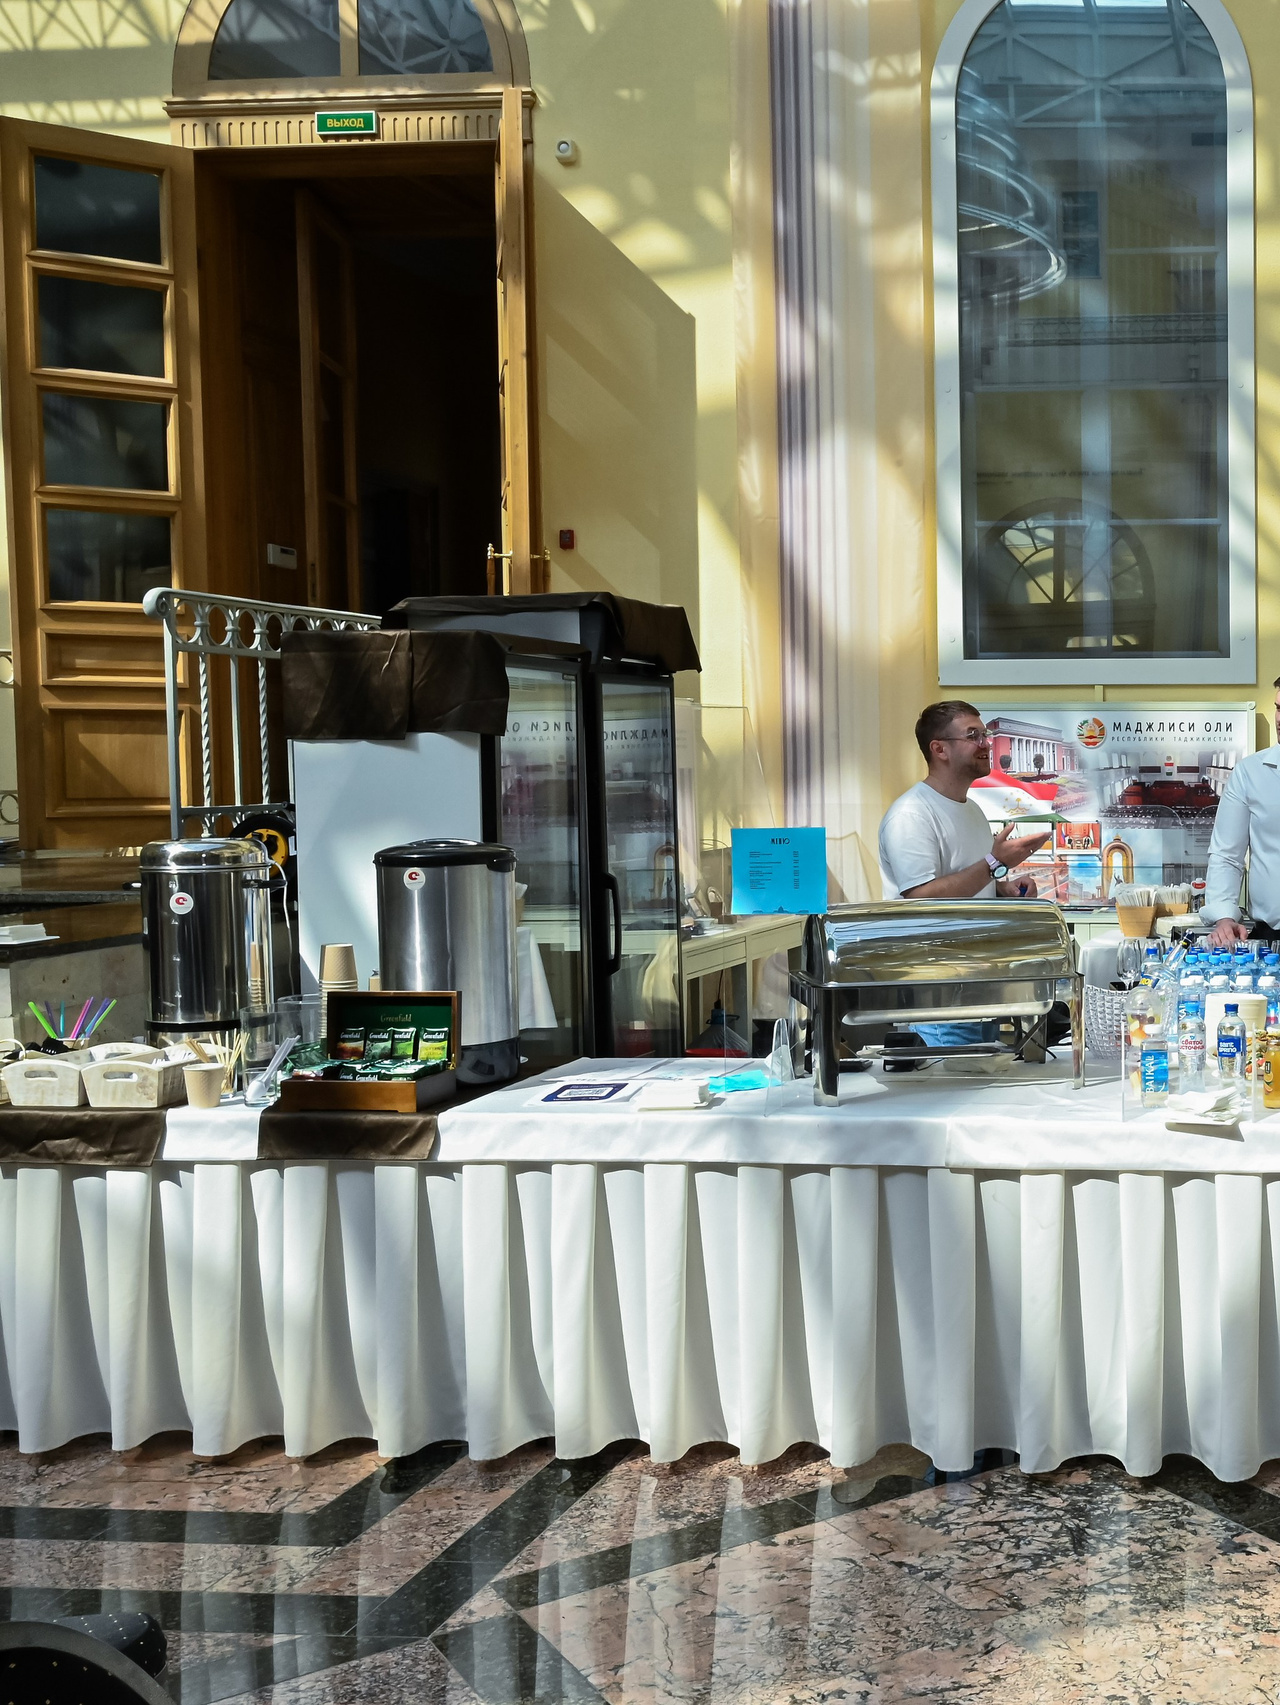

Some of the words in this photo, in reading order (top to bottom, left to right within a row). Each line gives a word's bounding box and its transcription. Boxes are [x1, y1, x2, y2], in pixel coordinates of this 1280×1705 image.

[326, 118, 365, 128] ВЫХОД
[1113, 722, 1195, 734] МАДЖЛИСИ
[1204, 721, 1233, 733] ОЛИ
[381, 1014, 411, 1022] Greenfield
[1145, 1055, 1155, 1093] BAIKAL
